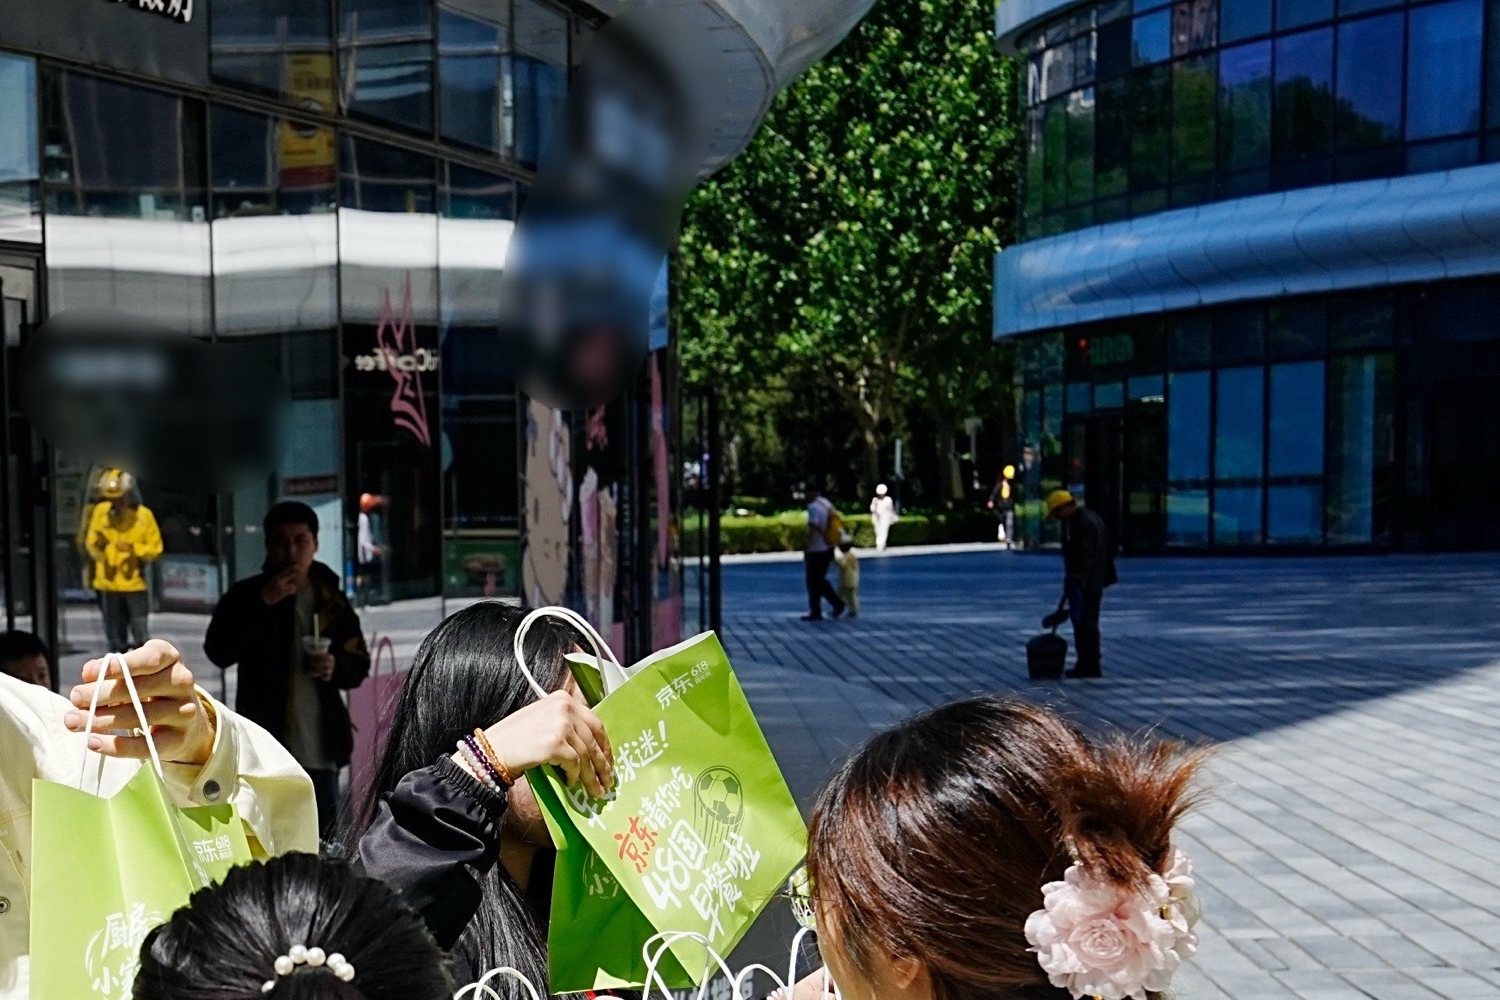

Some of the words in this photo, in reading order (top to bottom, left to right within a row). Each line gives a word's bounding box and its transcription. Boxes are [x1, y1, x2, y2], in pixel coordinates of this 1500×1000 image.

[655, 671, 694, 711] 京东
[691, 660, 709, 677] 618
[215, 834, 231, 850] 618
